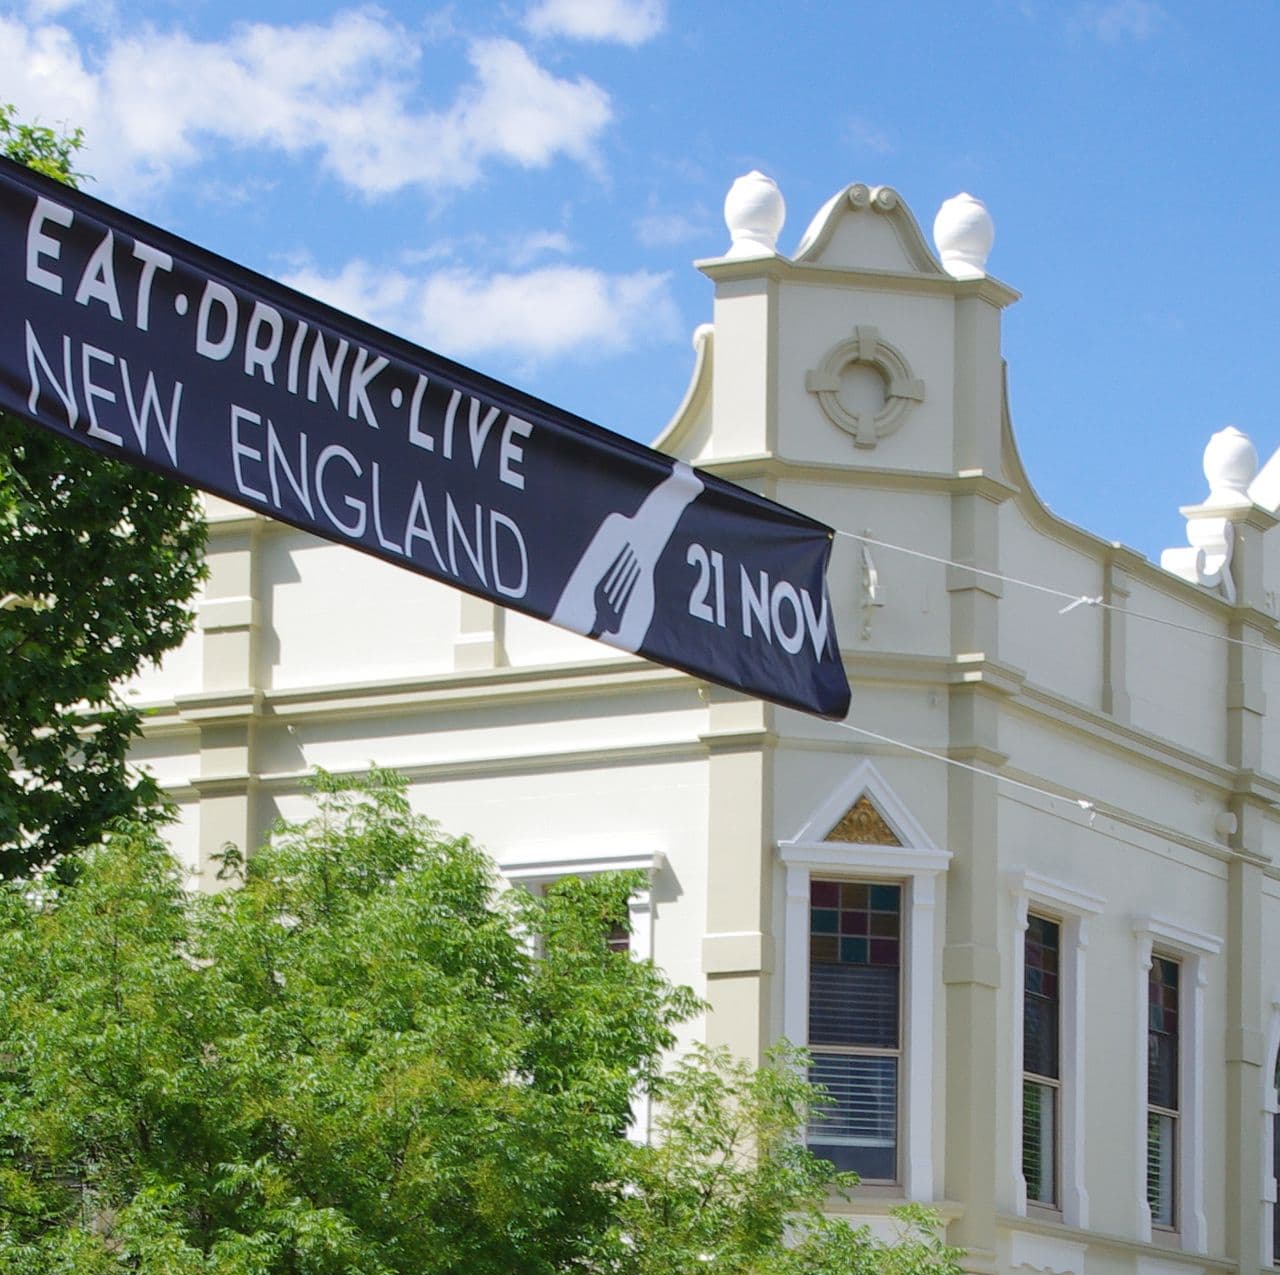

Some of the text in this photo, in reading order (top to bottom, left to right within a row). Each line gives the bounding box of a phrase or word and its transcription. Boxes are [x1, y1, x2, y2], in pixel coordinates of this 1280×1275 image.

[24, 318, 529, 600] NEW ENGLAND
[686, 543, 833, 665] 21 NOV
